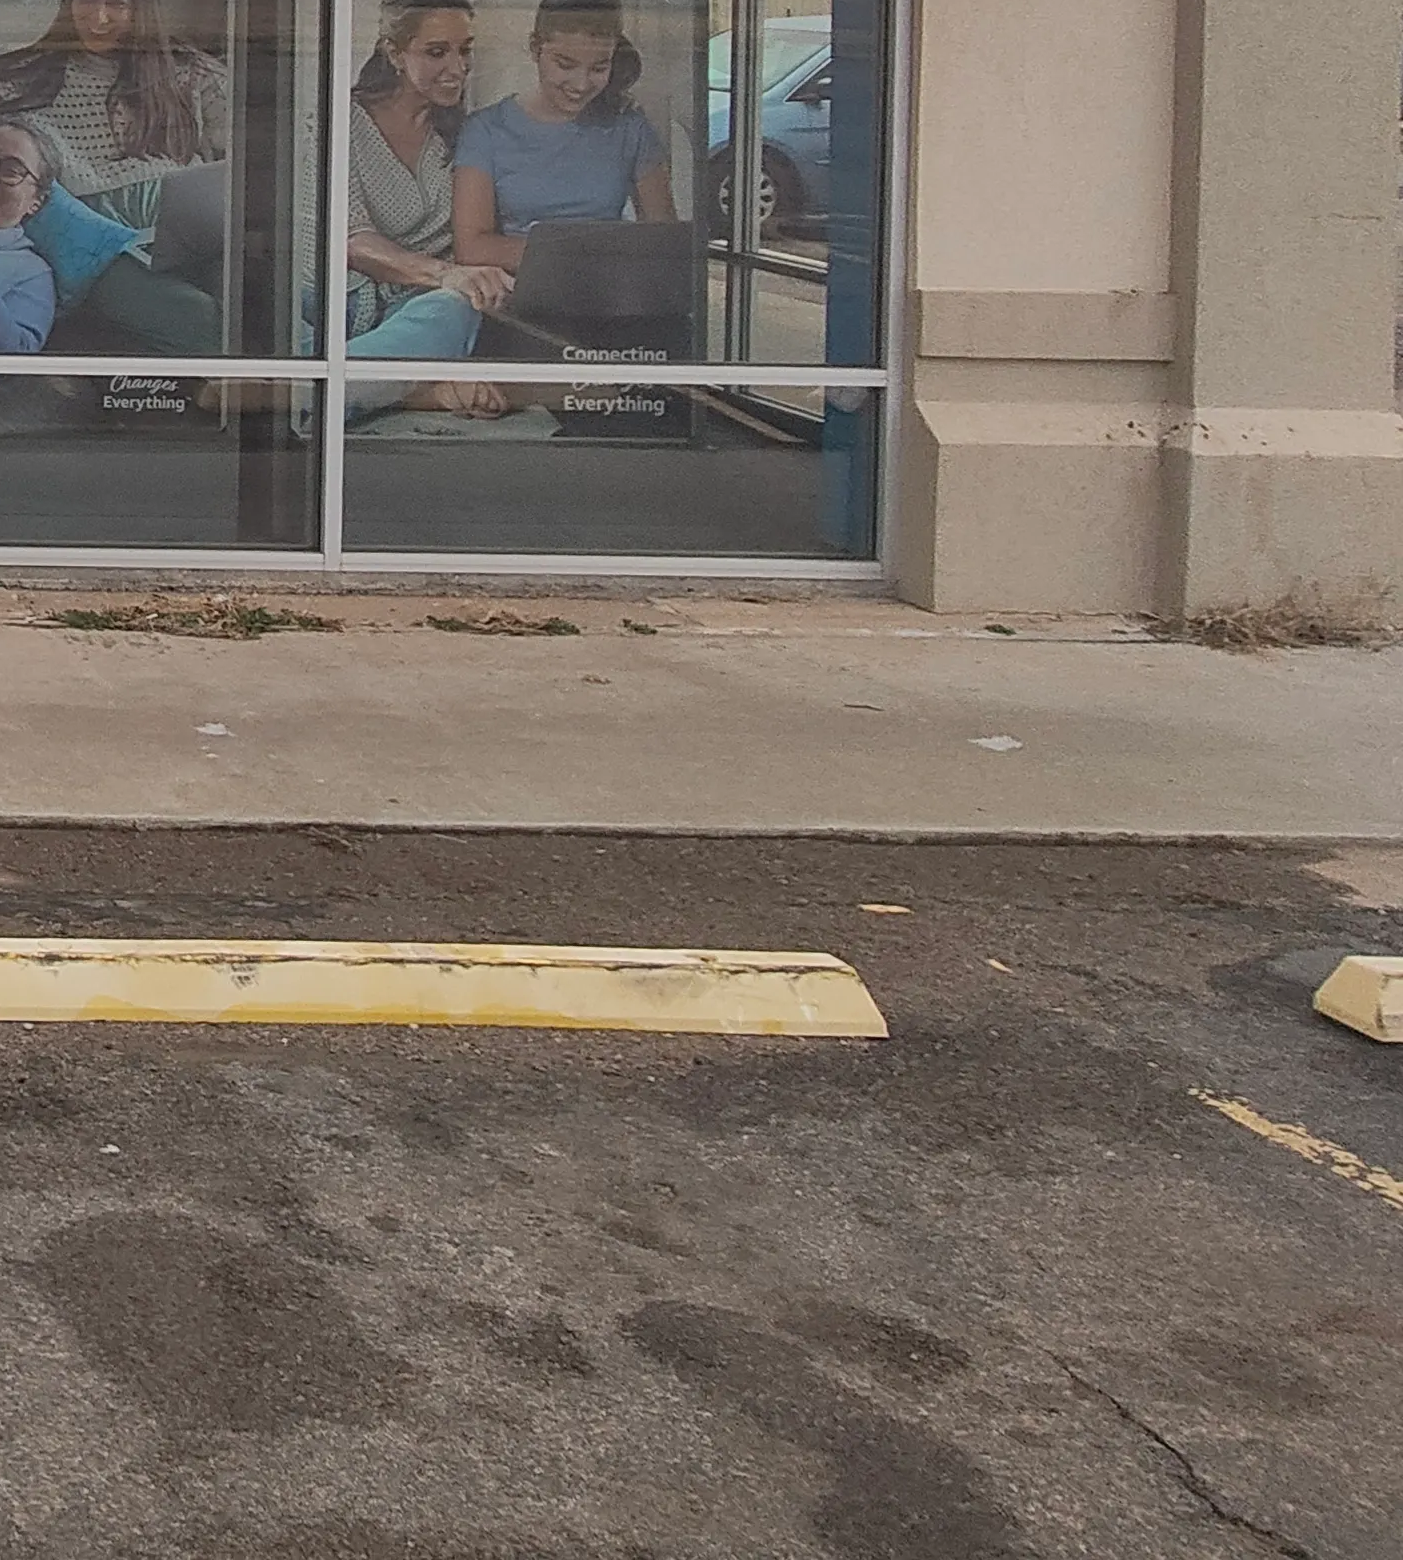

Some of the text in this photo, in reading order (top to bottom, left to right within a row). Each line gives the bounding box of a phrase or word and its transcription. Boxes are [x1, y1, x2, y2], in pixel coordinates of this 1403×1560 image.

[109, 375, 180, 394] Changes
[103, 395, 186, 413] Everything
[563, 395, 665, 416] Everything
